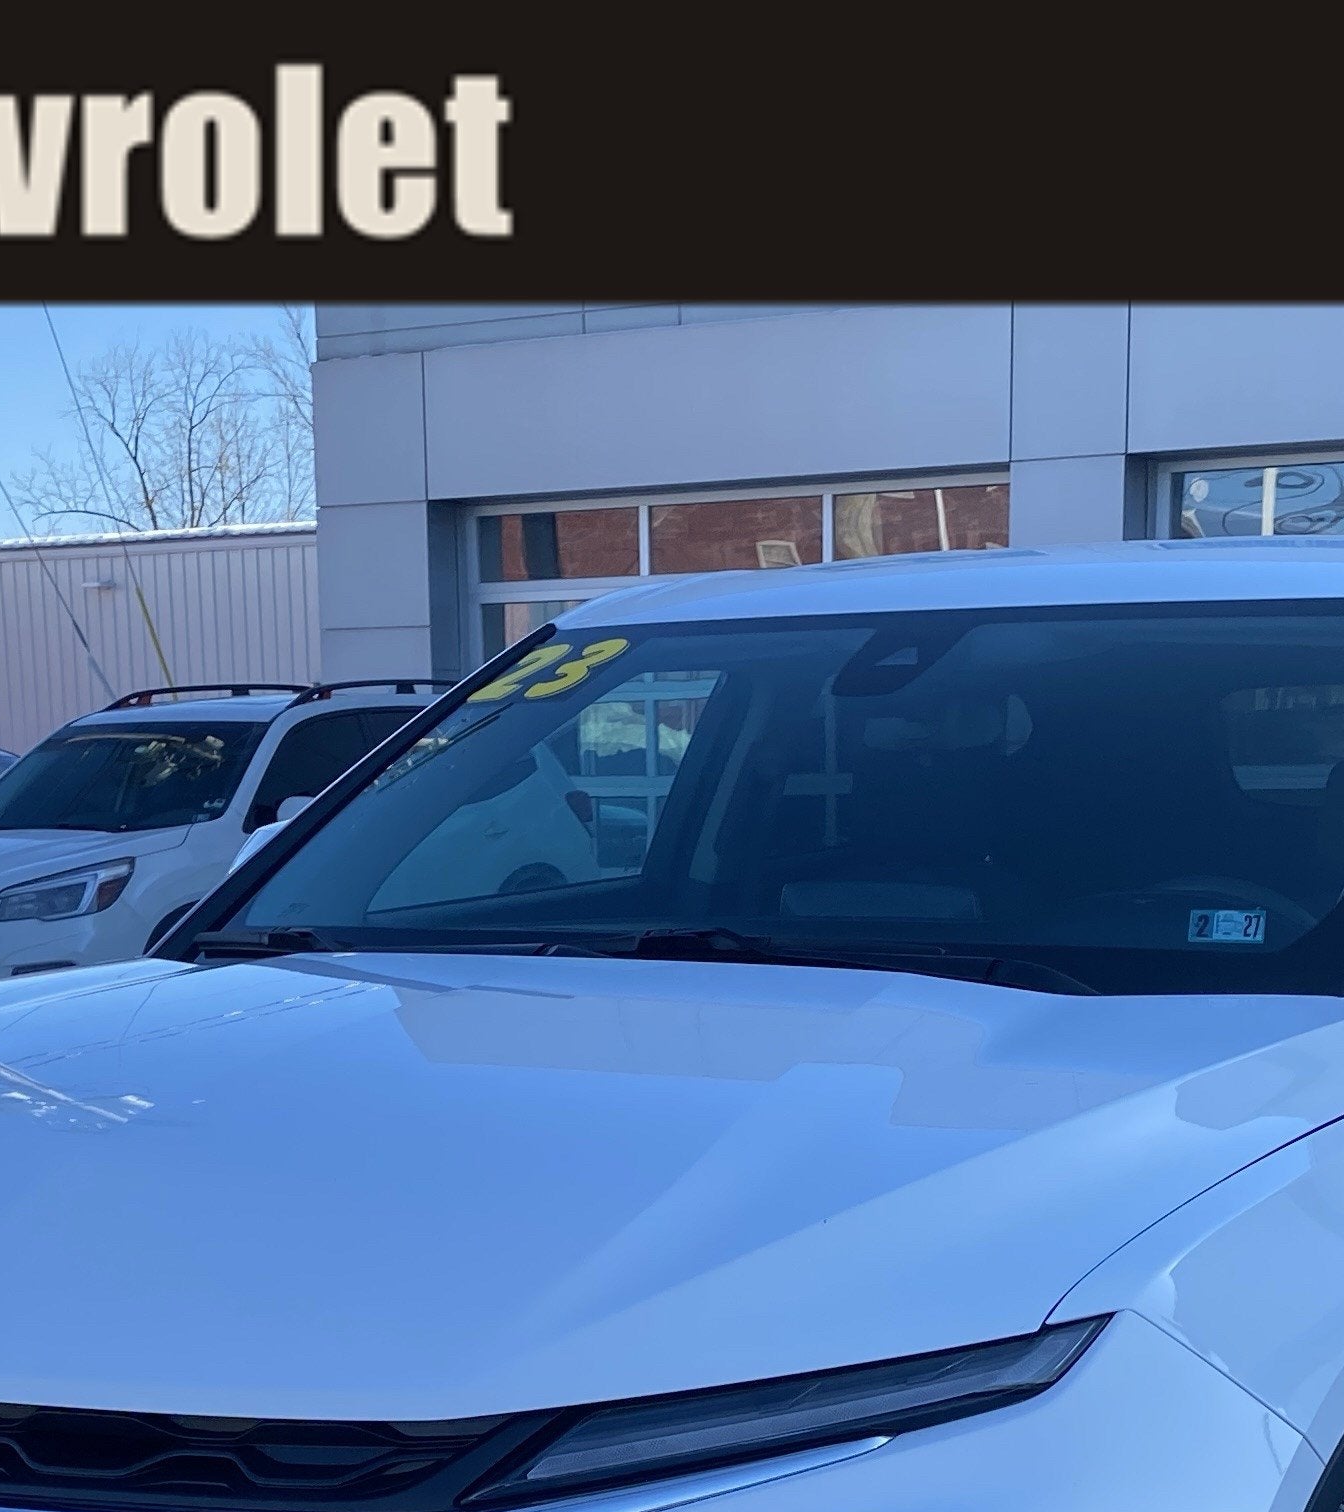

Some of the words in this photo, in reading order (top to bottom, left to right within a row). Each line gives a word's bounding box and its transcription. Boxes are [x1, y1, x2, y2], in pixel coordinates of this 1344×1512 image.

[466, 637, 631, 703] 23
[1195, 914, 1210, 938] 2
[1243, 914, 1262, 939] 27
